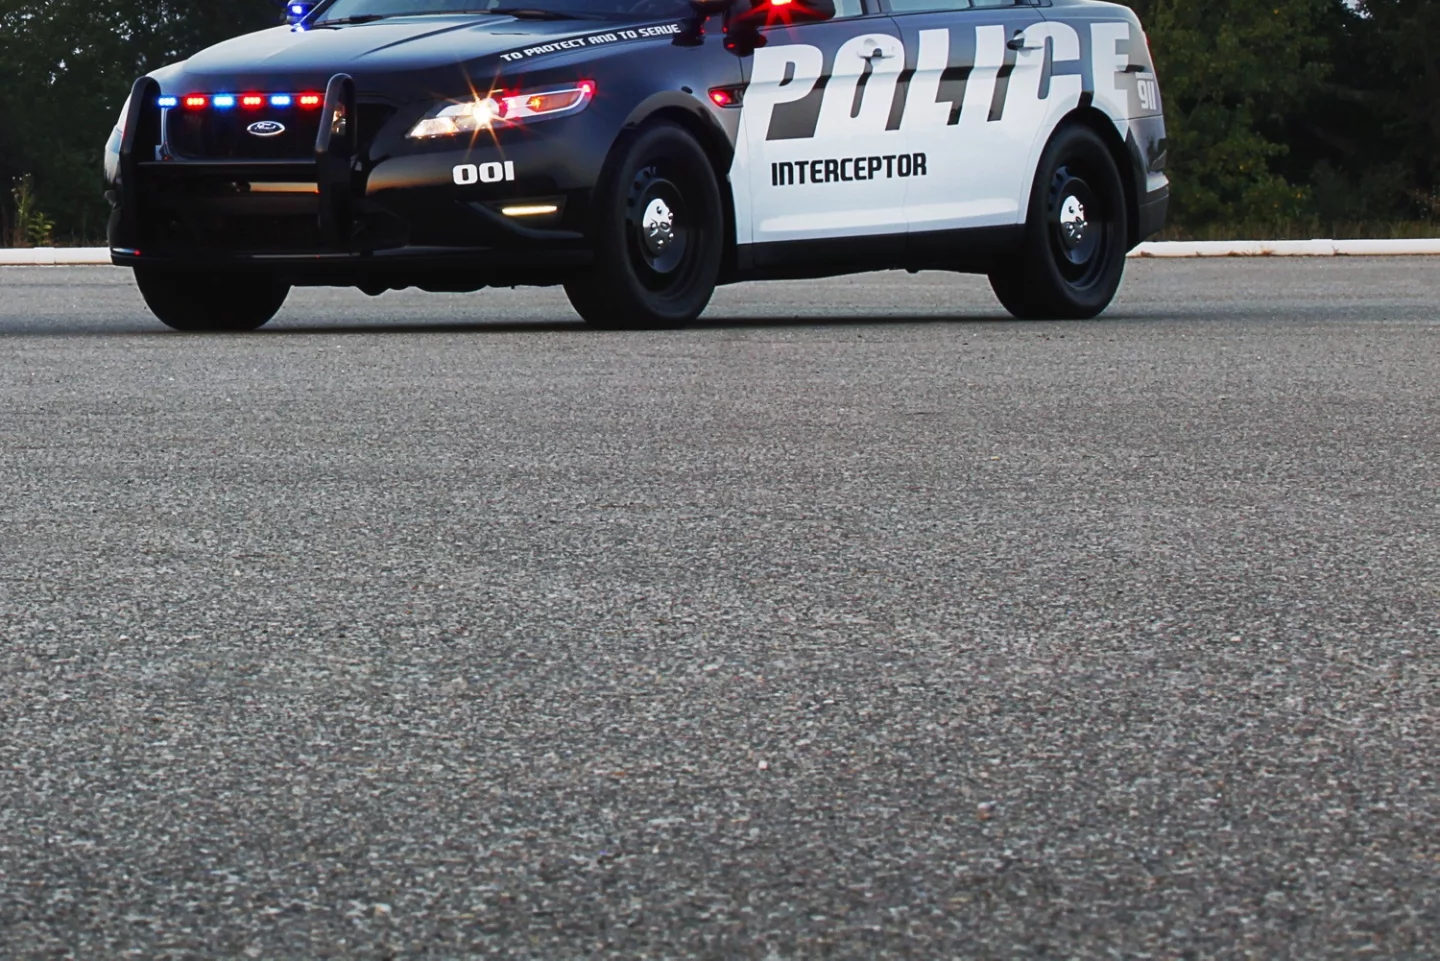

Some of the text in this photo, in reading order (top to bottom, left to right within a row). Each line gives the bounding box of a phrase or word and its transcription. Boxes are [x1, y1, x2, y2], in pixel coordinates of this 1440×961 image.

[500, 23, 681, 62] TO PROTECT AND TO SERVE
[738, 21, 1130, 141] POLICE
[1137, 80, 1157, 110] 911
[452, 160, 516, 186] 001
[771, 152, 928, 187] INTERCEPTOR
